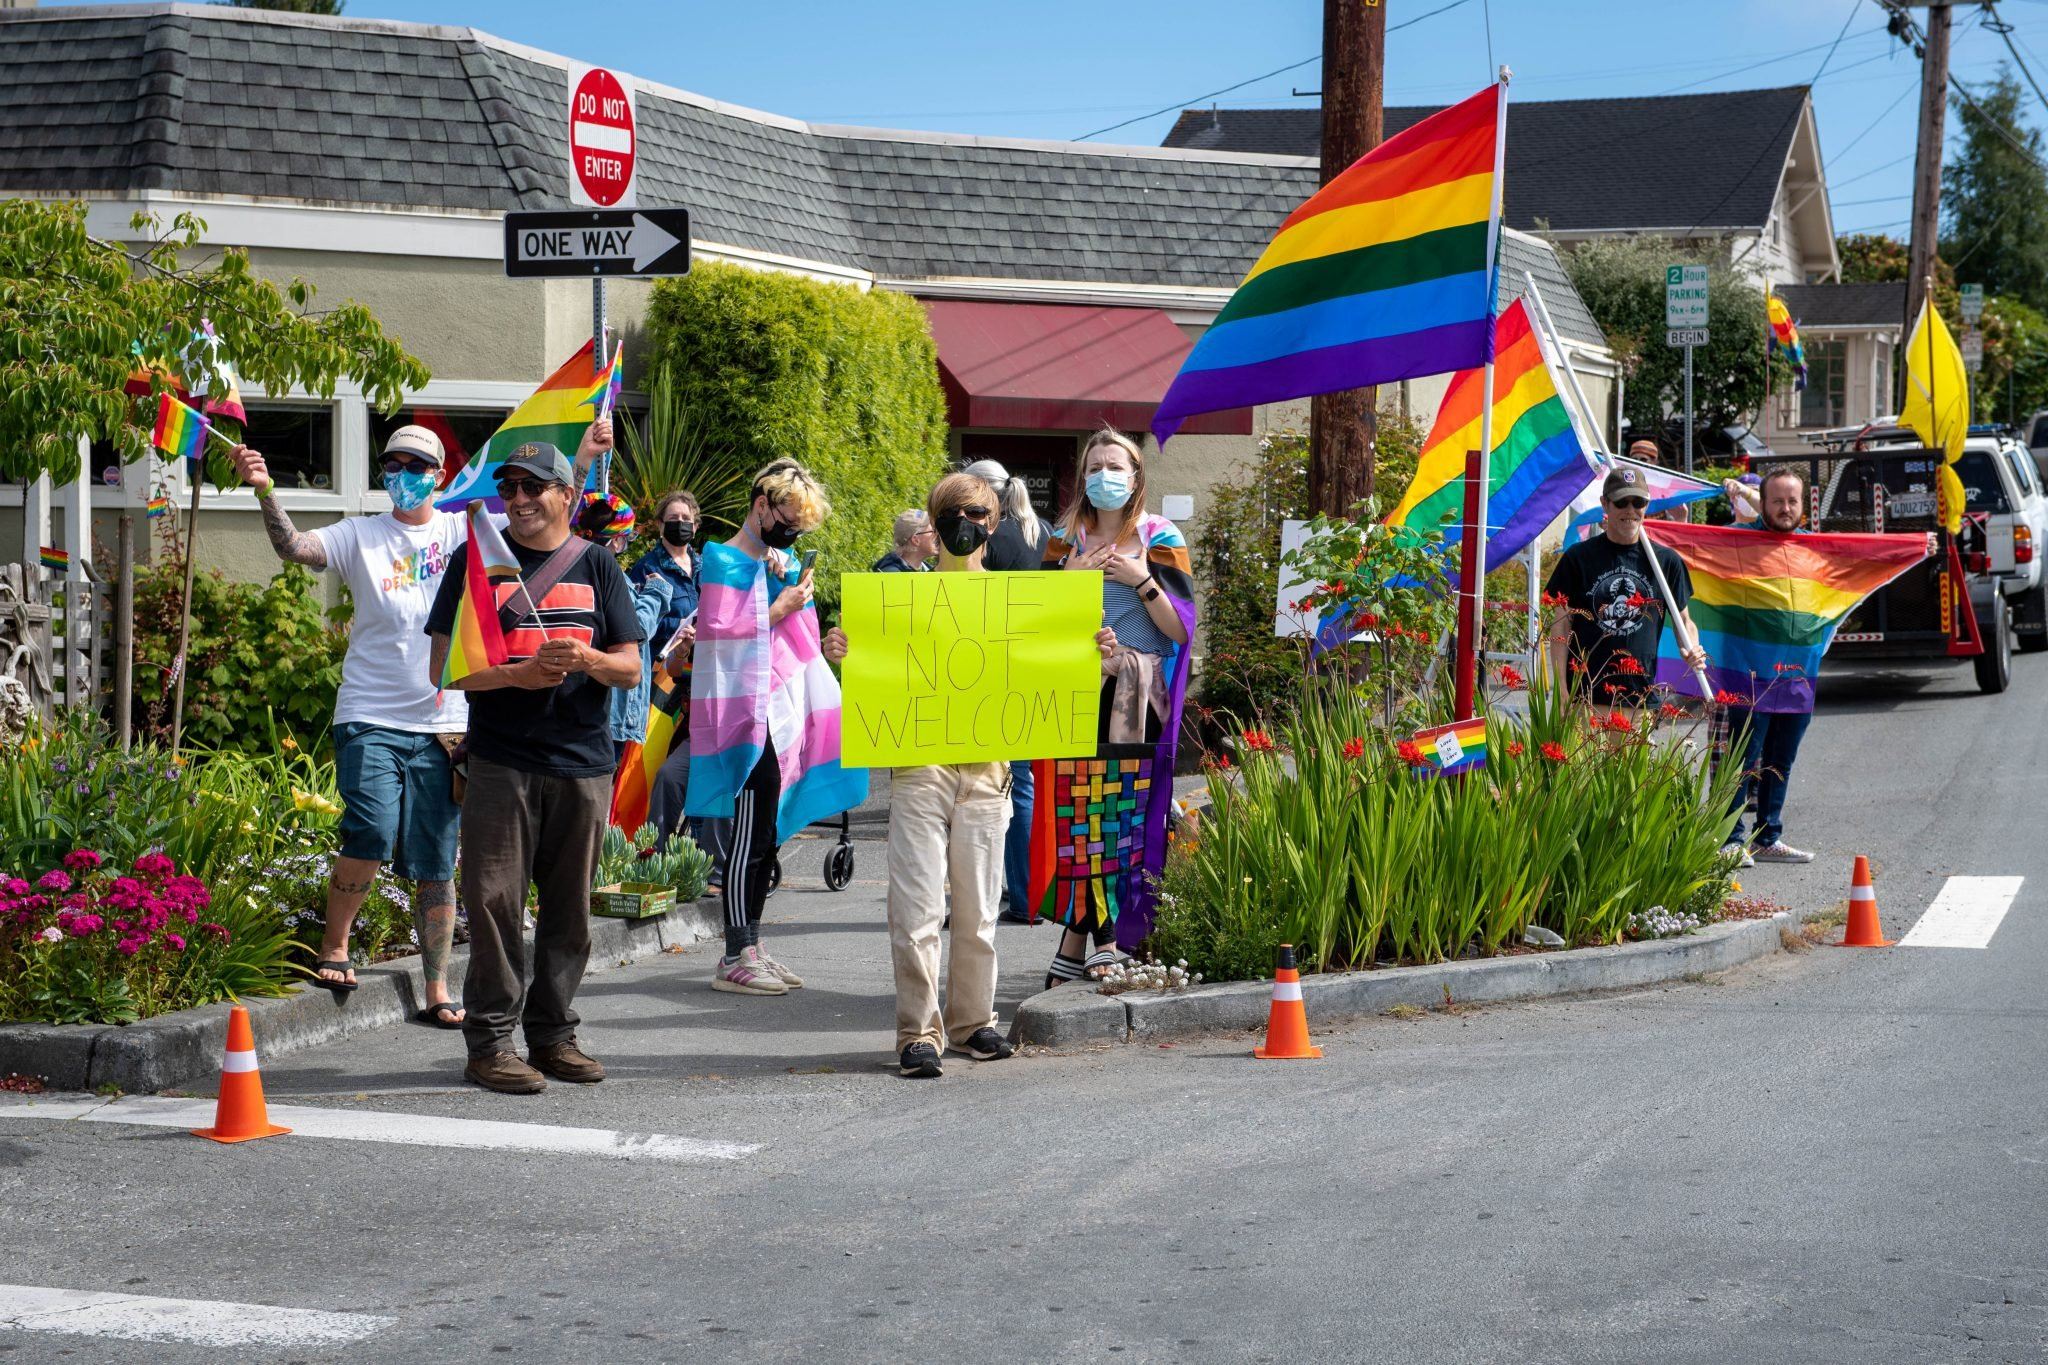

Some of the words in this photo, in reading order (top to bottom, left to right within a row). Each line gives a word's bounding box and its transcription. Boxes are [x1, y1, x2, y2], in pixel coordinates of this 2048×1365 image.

[579, 93, 596, 116] DO
[603, 97, 625, 121] NOT
[585, 155, 622, 181] ENTER
[525, 232, 573, 257] ONE
[582, 230, 633, 255] WAY
[1670, 269, 1680, 283] 2
[1684, 271, 1706, 281] HOUR
[1669, 288, 1706, 300] PARKING
[1671, 331, 1704, 344] BEGIN
[881, 576, 1046, 636] HATE
[907, 637, 1025, 691] NOT
[855, 689, 1097, 749] WELCOME
